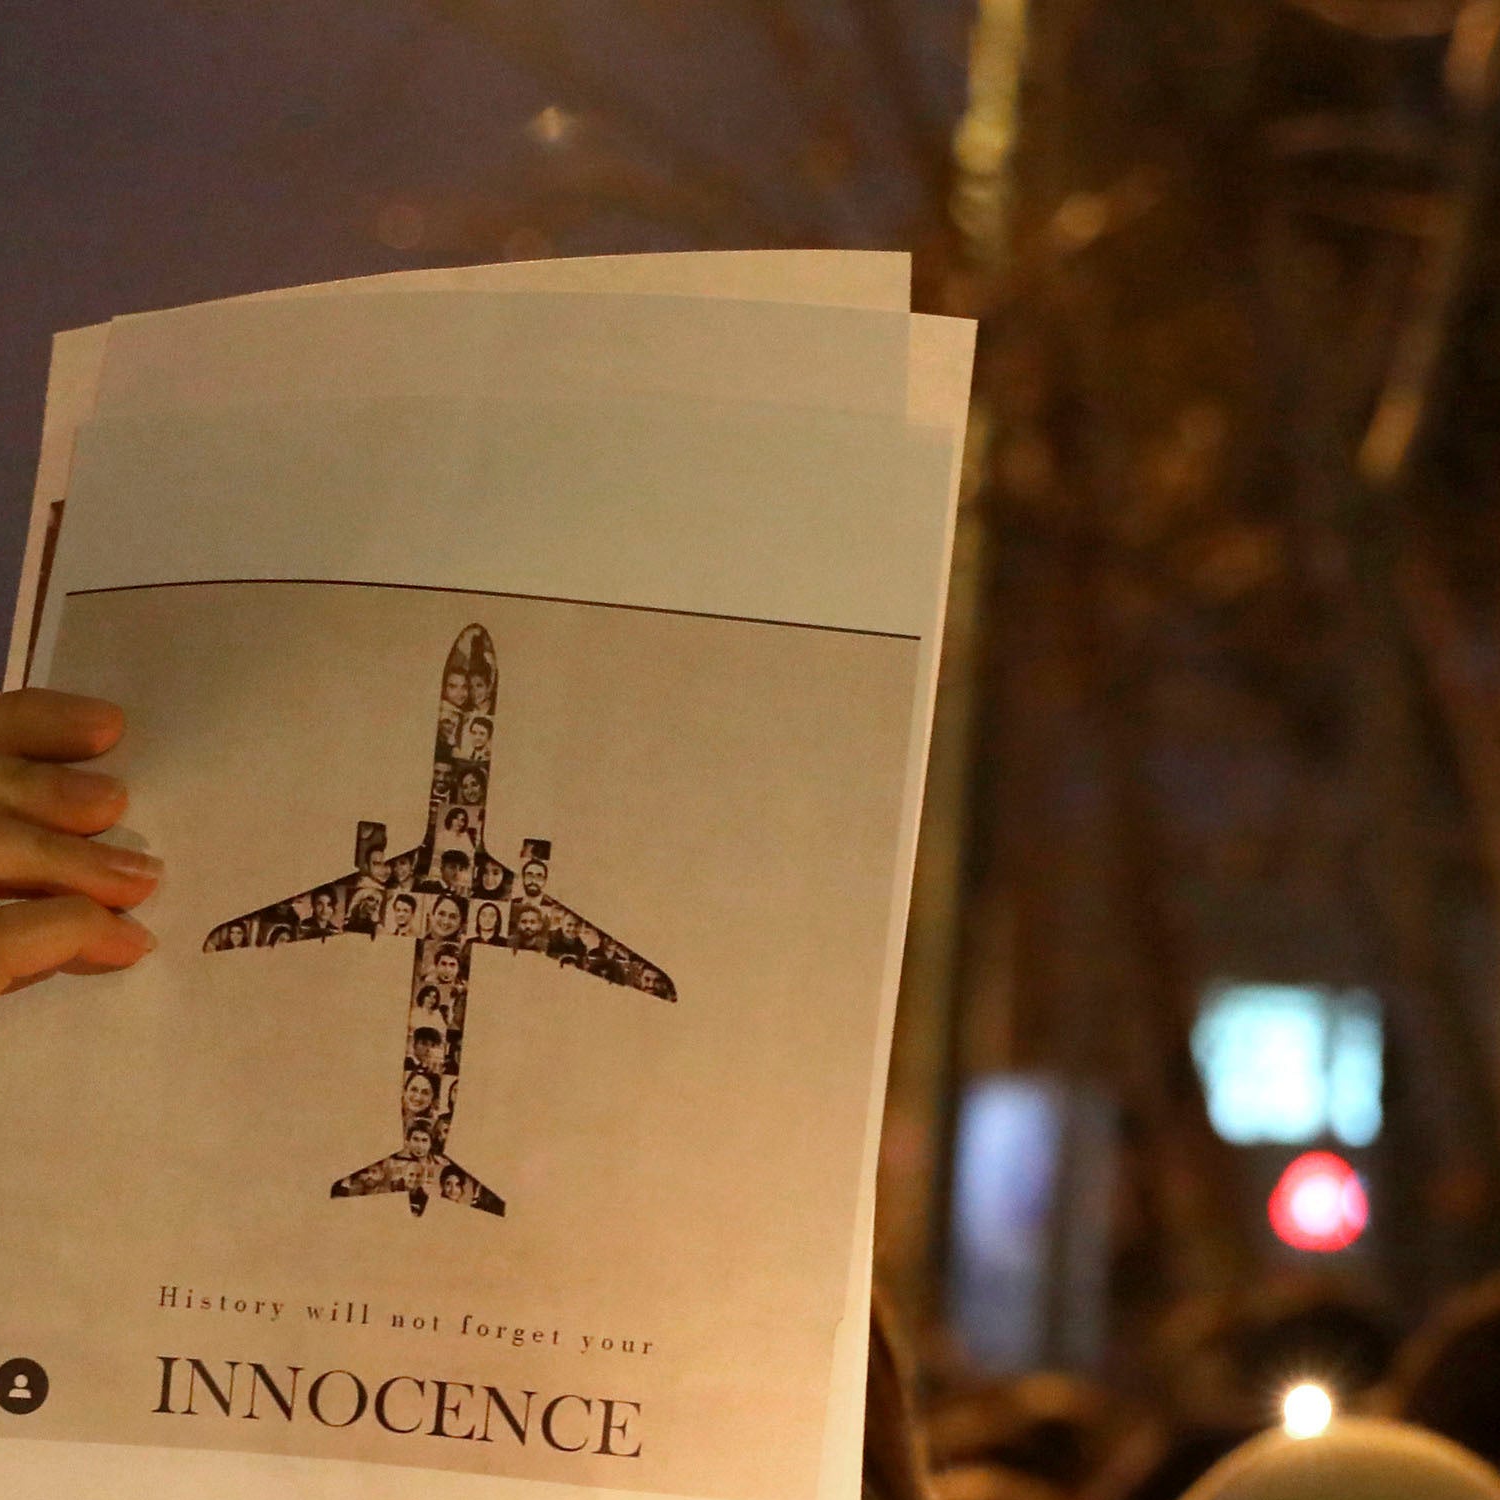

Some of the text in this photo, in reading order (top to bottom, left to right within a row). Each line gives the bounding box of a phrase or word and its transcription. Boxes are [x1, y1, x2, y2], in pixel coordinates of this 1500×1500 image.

[157, 1284, 655, 1356] History will not forget your
[150, 1354, 644, 1460] INNOCENCE
